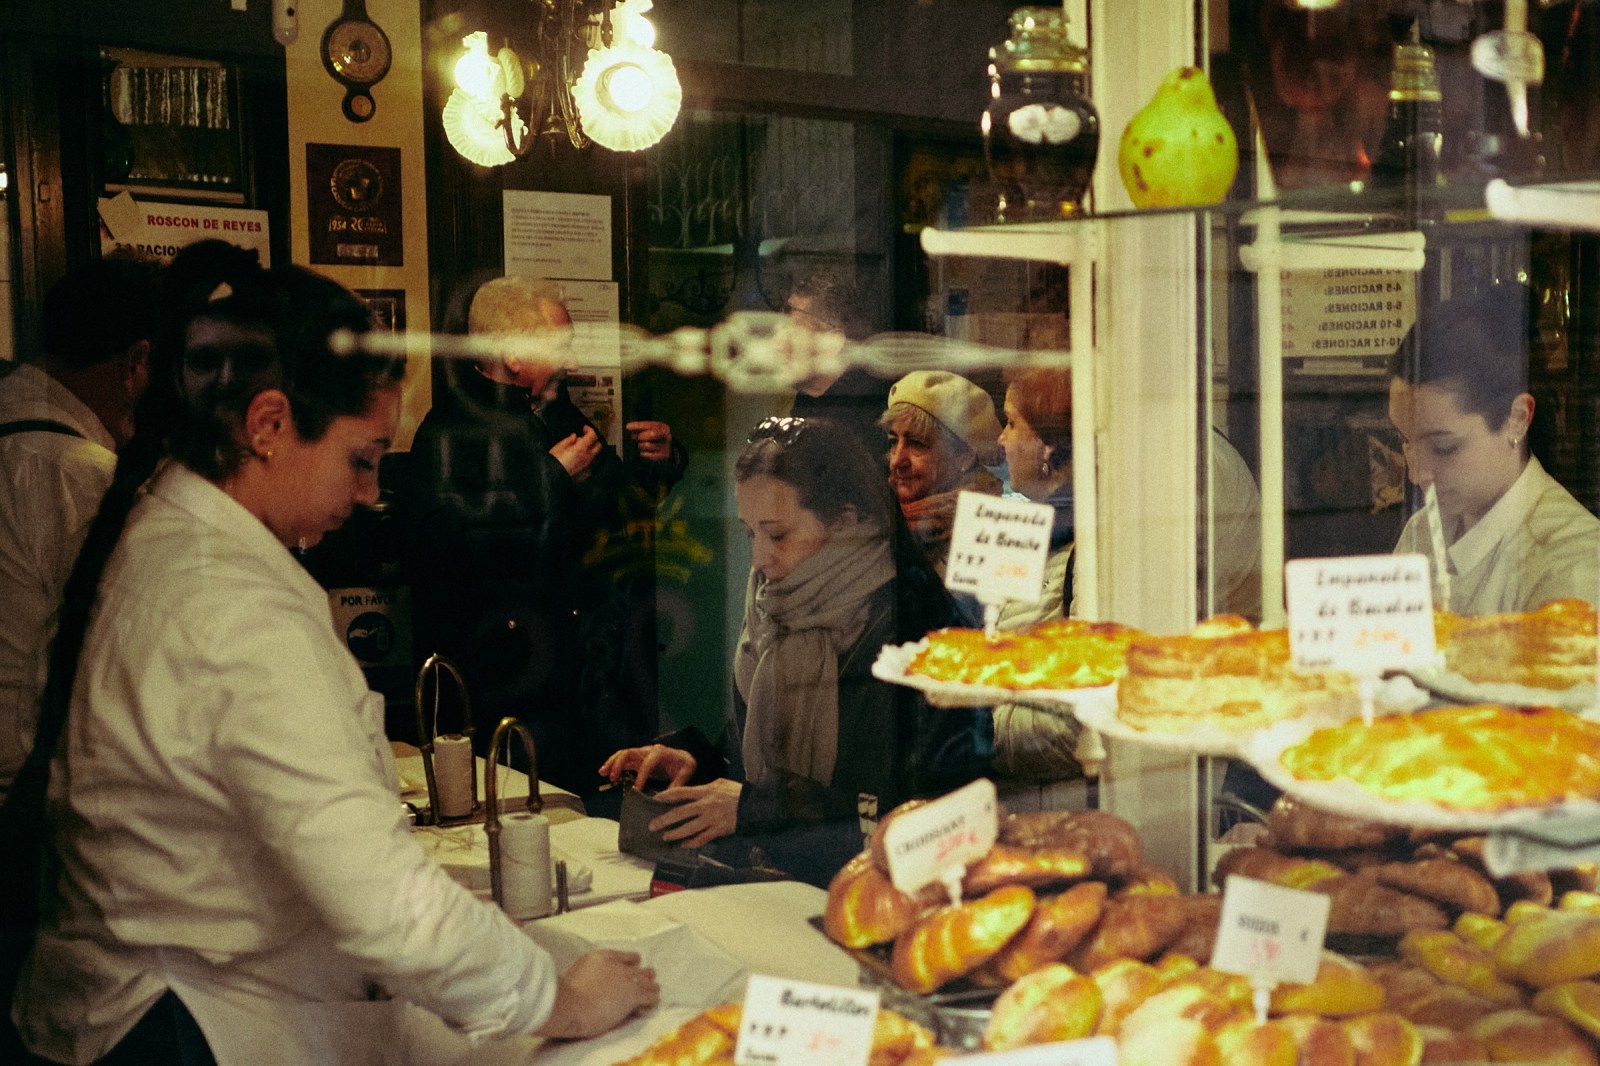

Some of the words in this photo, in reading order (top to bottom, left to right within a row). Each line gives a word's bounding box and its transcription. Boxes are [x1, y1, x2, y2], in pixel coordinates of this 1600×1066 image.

[147, 214, 199, 228] ROSCON
[203, 219, 219, 230] DE
[223, 220, 262, 232] REYES
[340, 595, 363, 607] POR
